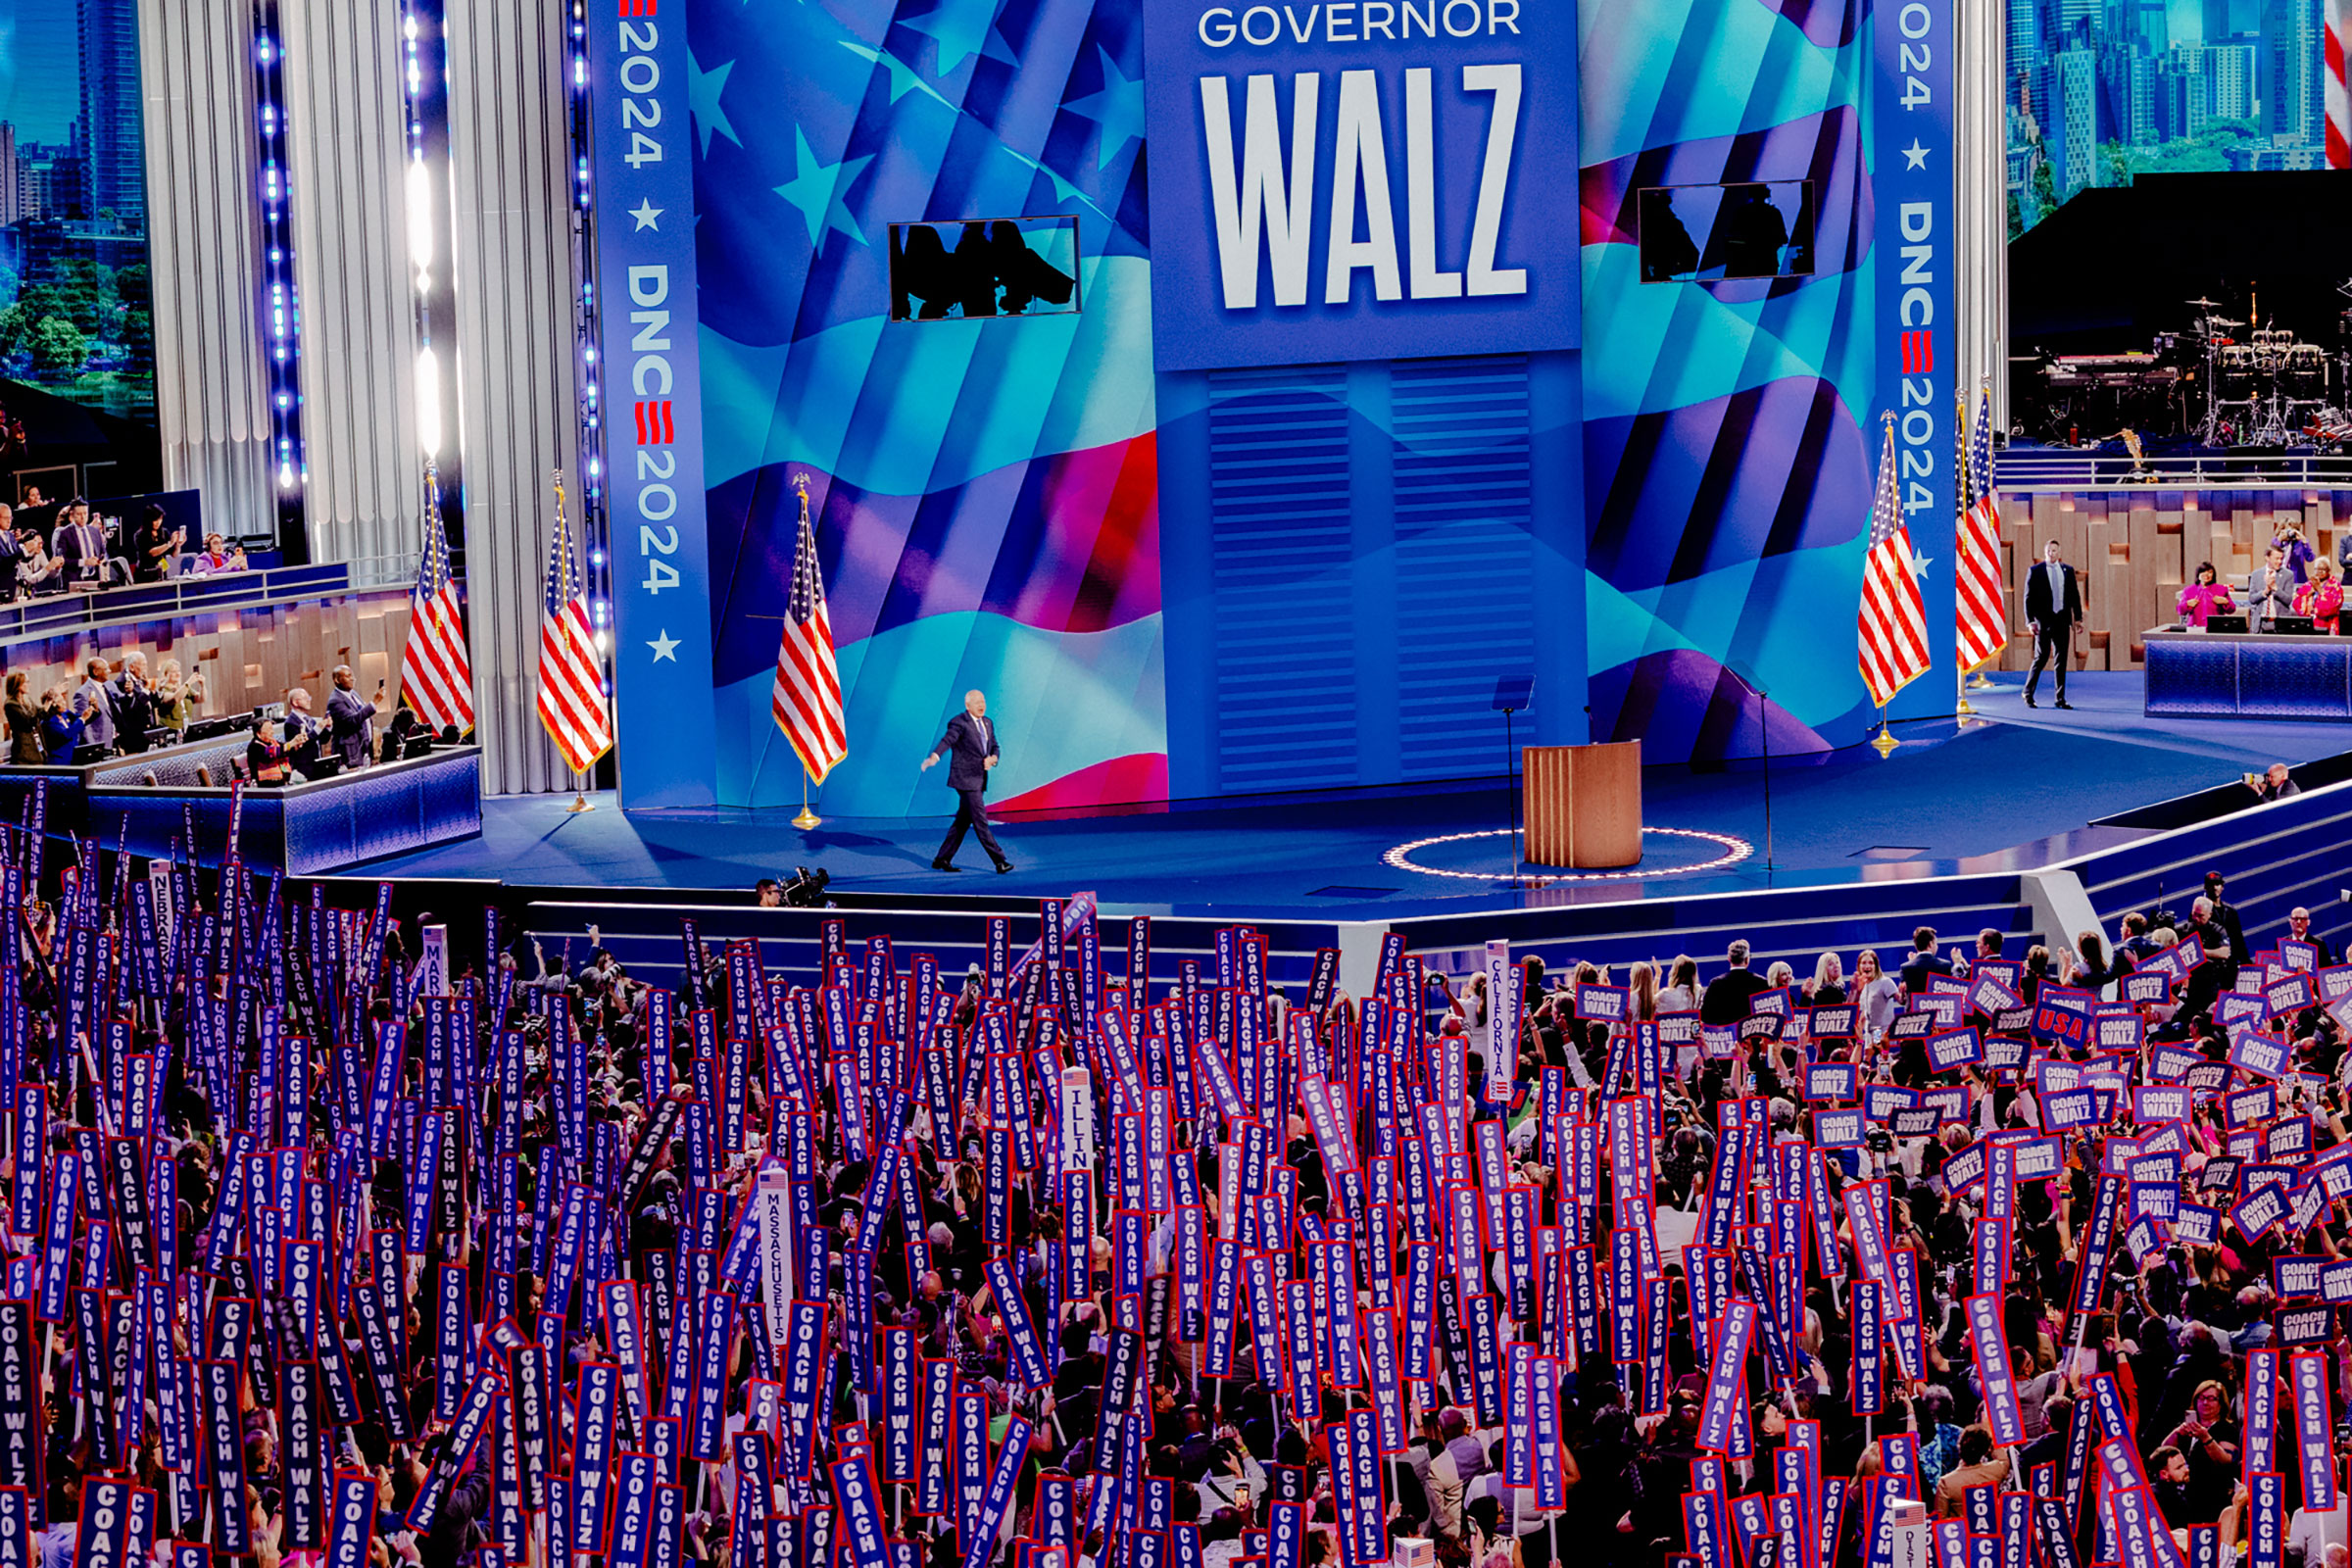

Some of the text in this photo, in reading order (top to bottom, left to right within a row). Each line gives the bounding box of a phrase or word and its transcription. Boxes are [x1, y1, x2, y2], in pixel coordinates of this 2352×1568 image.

[1199, 0, 1521, 47] GOVERNOR
[1899, 2, 1932, 111] 024
[618, 22, 662, 169] 2024
[1200, 64, 1527, 309] WALZ
[1899, 202, 1934, 516] DNC 2024
[628, 265, 680, 595] DNC 2024
[221, 869, 234, 969] COACH WALZ
[1048, 901, 1060, 1002] COACH WALZ
[2285, 946, 2313, 959] COACH
[1085, 939, 1095, 1041] COACH WALZ
[1491, 958, 1504, 1077] CALIFORNIA
[1584, 990, 1621, 1003] COACH
[1584, 1001, 1620, 1016] WALZ
[1815, 1019, 1849, 1033] WALZ
[1816, 1009, 1851, 1020] COACH
[2037, 1008, 2083, 1042] USA
[2100, 1021, 2135, 1032] COACH
[2100, 1031, 2135, 1045] WALZ
[2129, 977, 2162, 990] COACH
[2129, 988, 2163, 1001] WALZ
[2268, 980, 2301, 998] COACH
[2271, 991, 2305, 1012] WALZ
[370, 1025, 397, 1152] COACH WALZ
[504, 1033, 517, 1149] COACH WALZ
[728, 1045, 744, 1149] COACH WALZ
[1241, 996, 1252, 1102] COACH WALZ
[1447, 1040, 1460, 1153] COACH WALZ
[1812, 1070, 1848, 1080] COACH
[1812, 1080, 1848, 1095] WALZ
[1934, 1034, 1971, 1053] COACH
[1936, 1044, 1975, 1065] WALZ
[2142, 1093, 2182, 1103] COACH
[2240, 1049, 2279, 1073] WALZ
[2244, 1039, 2282, 1059] COACH
[344, 1050, 366, 1177] COACH WALZ
[930, 1053, 954, 1156] COACH WALZ
[1007, 1057, 1033, 1166] COACH WALZ
[1071, 1090, 1087, 1168] ILLIN
[1151, 1091, 1164, 1207] COACH WALZ
[1821, 1115, 1857, 1128] COACH
[1822, 1128, 1859, 1143] WALZ
[2050, 1094, 2089, 1110] COACH
[2051, 1105, 2091, 1124] WALZ
[2142, 1103, 2183, 1117] WALZ
[2231, 1092, 2270, 1109] COACH
[2232, 1101, 2271, 1123] WALZ
[2270, 1123, 2304, 1142] COACH
[2270, 1133, 2305, 1154] WALZ
[21, 1090, 36, 1229] COACH WALZ
[410, 1115, 436, 1249] COACH WALZ
[441, 1109, 458, 1228] COACH WALZ
[990, 1132, 1004, 1239] COACH WALZ
[1712, 1130, 1739, 1246] COACH WALZ
[1810, 1152, 1836, 1271] COACH WALZ
[1947, 1149, 1981, 1175] COACH
[1949, 1159, 1984, 1188] WALZ
[2132, 1158, 2173, 1174] COACH
[2137, 1189, 2175, 1200] COACH
[2239, 1190, 2277, 1221] COACH
[46, 1156, 74, 1315] COACH WALZ
[767, 1194, 785, 1339] MASSACHUSETTS
[1071, 1174, 1085, 1296] COACH WALZ
[1511, 1193, 1527, 1314] COACH WALZ
[2082, 1178, 2116, 1307] COACH WALZ
[2244, 1200, 2283, 1233] WALZ
[992, 1261, 1043, 1384] COACH WALZ
[1184, 1209, 1199, 1336] COACH WALZ
[1211, 1244, 1233, 1371] COACH WALZ
[1333, 1246, 1351, 1381] COACH WALZ
[1411, 1247, 1429, 1374] COACH WALZ
[1619, 1233, 1635, 1358] COACH WALZ
[2282, 1310, 2327, 1326] COACH
[153, 1288, 176, 1461] COACH WALZ
[320, 1354, 349, 1417] WALZ
[359, 1288, 404, 1436] COACH WALZ
[442, 1268, 459, 1417] COACH WALZ
[700, 1297, 725, 1453] COACH WALZ
[1293, 1284, 1314, 1413] COACH WALZ
[1373, 1312, 1397, 1447] COACH WALZ
[1475, 1298, 1495, 1422] COACH WALZ
[1707, 1305, 1746, 1444] COACH WALZ
[1859, 1284, 1876, 1409] COACH WALZ
[1973, 1298, 2014, 1439] COACH WALZ
[2282, 1321, 2326, 1341] WALZ
[212, 1366, 240, 1547] COACH WALZ
[291, 1366, 310, 1457] COACH
[416, 1376, 496, 1526] COACH WALZ
[520, 1350, 544, 1505] COACH WALZ
[892, 1331, 908, 1475] COACH WALZ
[926, 1363, 948, 1508] COACH WALZ
[1100, 1334, 1132, 1470] COACH WALZ
[1512, 1346, 1529, 1481] COACH WALZ
[1535, 1359, 1555, 1502] COACH WALZ
[2300, 1358, 2327, 1504] COACH WALZ
[291, 1468, 311, 1542] WALZ
[969, 1422, 1025, 1568] COACH WALZ
[1356, 1413, 1378, 1556] COACH WALZ
